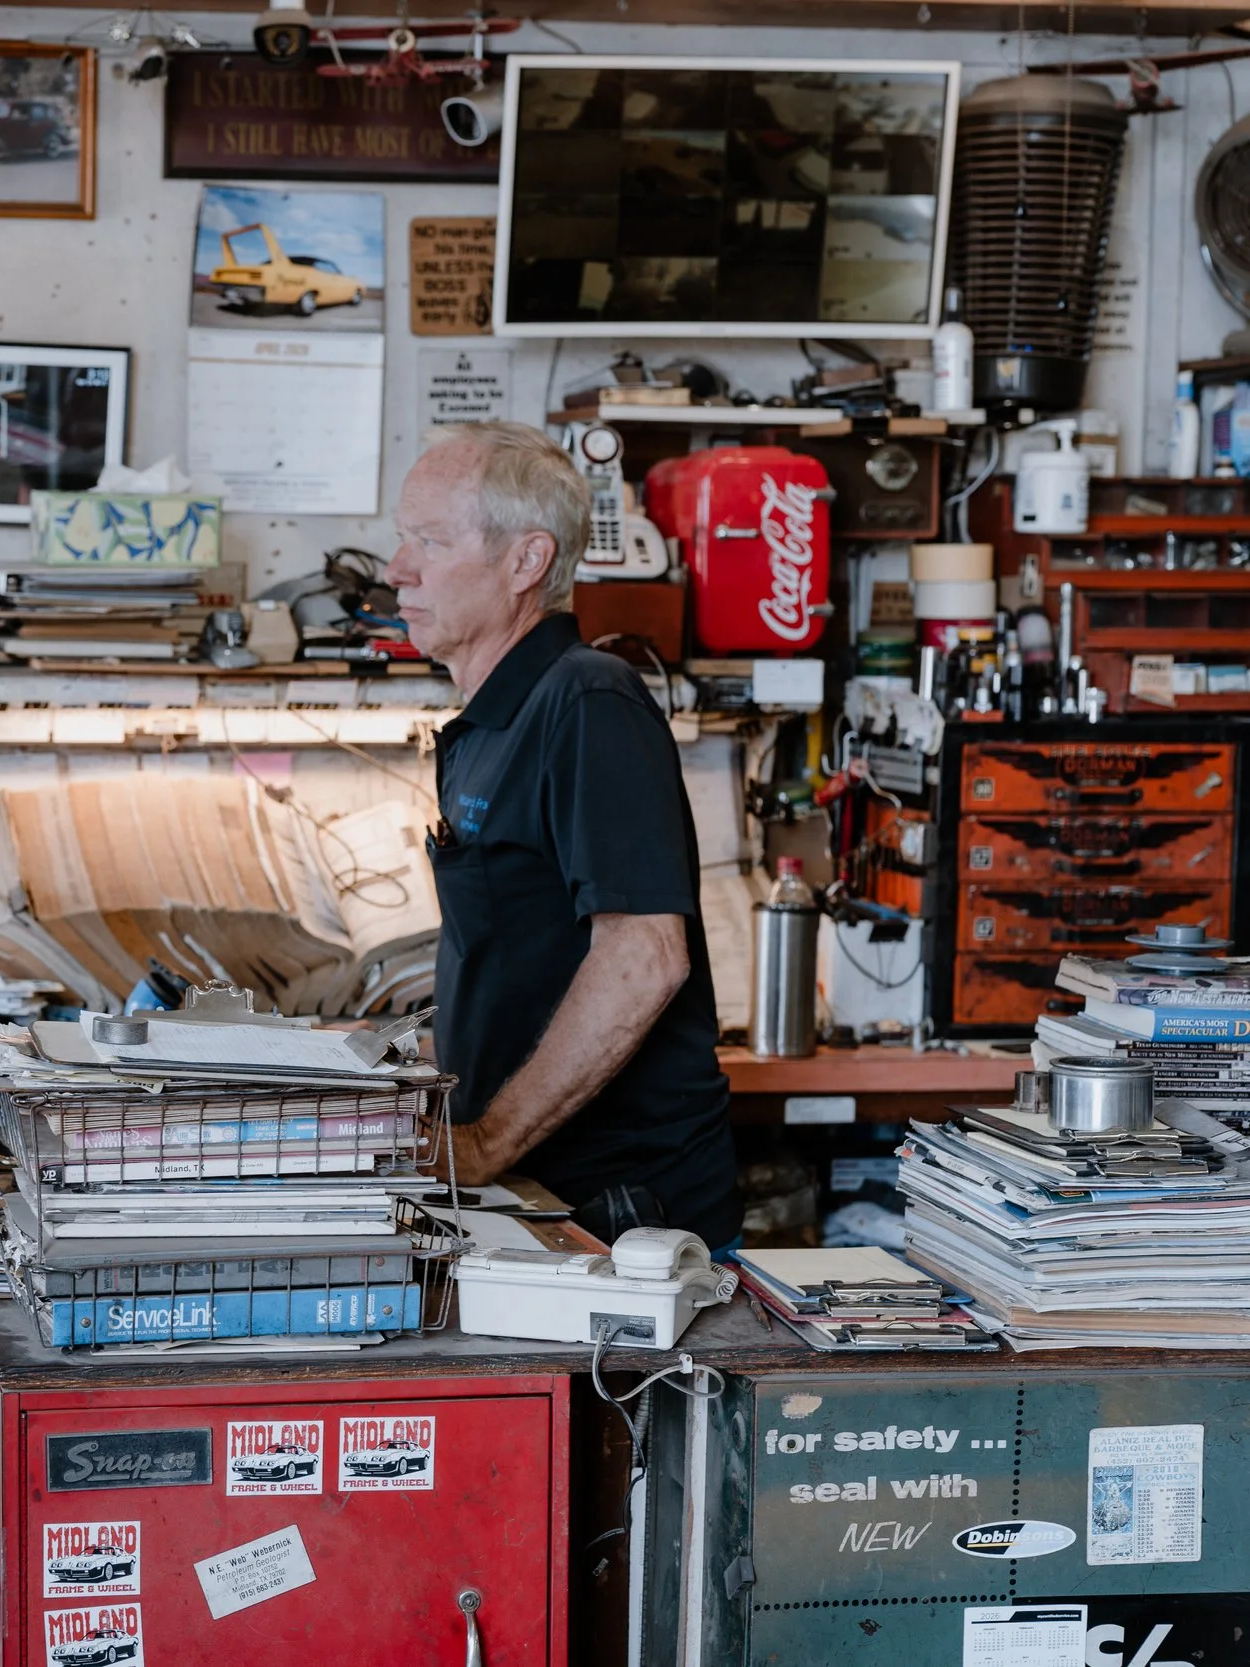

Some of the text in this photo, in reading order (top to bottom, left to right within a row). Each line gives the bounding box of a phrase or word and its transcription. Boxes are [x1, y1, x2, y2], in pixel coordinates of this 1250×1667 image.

[209, 72, 323, 109] STARTED
[223, 123, 282, 156] STILL
[293, 124, 344, 156] HAVE
[354, 125, 410, 157] MOST
[1161, 1027, 1229, 1036] SPECTACULAR
[1163, 1019, 1230, 1028] AMERICA'S MOST
[1153, 1070, 1178, 1078] RANGERS
[338, 1121, 384, 1137] Midland
[42, 1169, 56, 1180] yp
[154, 1165, 192, 1174] Midland,
[108, 1301, 219, 1330] ServiceLink
[331, 1300, 340, 1321] MOOG
[231, 1424, 320, 1458] MIDLAND
[344, 1419, 431, 1454] MIDLAND
[764, 1428, 822, 1455] for
[833, 1425, 960, 1453] safety
[1100, 1434, 1192, 1446] ALANIZ REAL PIT
[1093, 1444, 1151, 1453] BARBEQUE
[1166, 1442, 1198, 1450] MORE
[63, 1440, 195, 1482] Snap-on
[343, 1478, 430, 1487] FRAME & WHEEL
[1137, 1473, 1197, 1482] COWBOYS
[231, 1483, 318, 1492] FRAME & WHEEL
[789, 1474, 978, 1504] seal with
[47, 1525, 137, 1560] MIDLAND
[838, 1521, 932, 1552] NEW
[967, 1529, 1064, 1544] Dobinsons
[208, 1563, 225, 1575] N.E.
[251, 1537, 292, 1557] Webernick
[216, 1549, 291, 1583] Petroleum Geologist
[249, 1571, 260, 1580] Box
[259, 1574, 268, 1582] TX
[48, 1585, 84, 1594] FRAME
[97, 1584, 136, 1592] WHEEL
[980, 1612, 1000, 1620] 2026
[48, 1606, 138, 1649] MIDLAND
